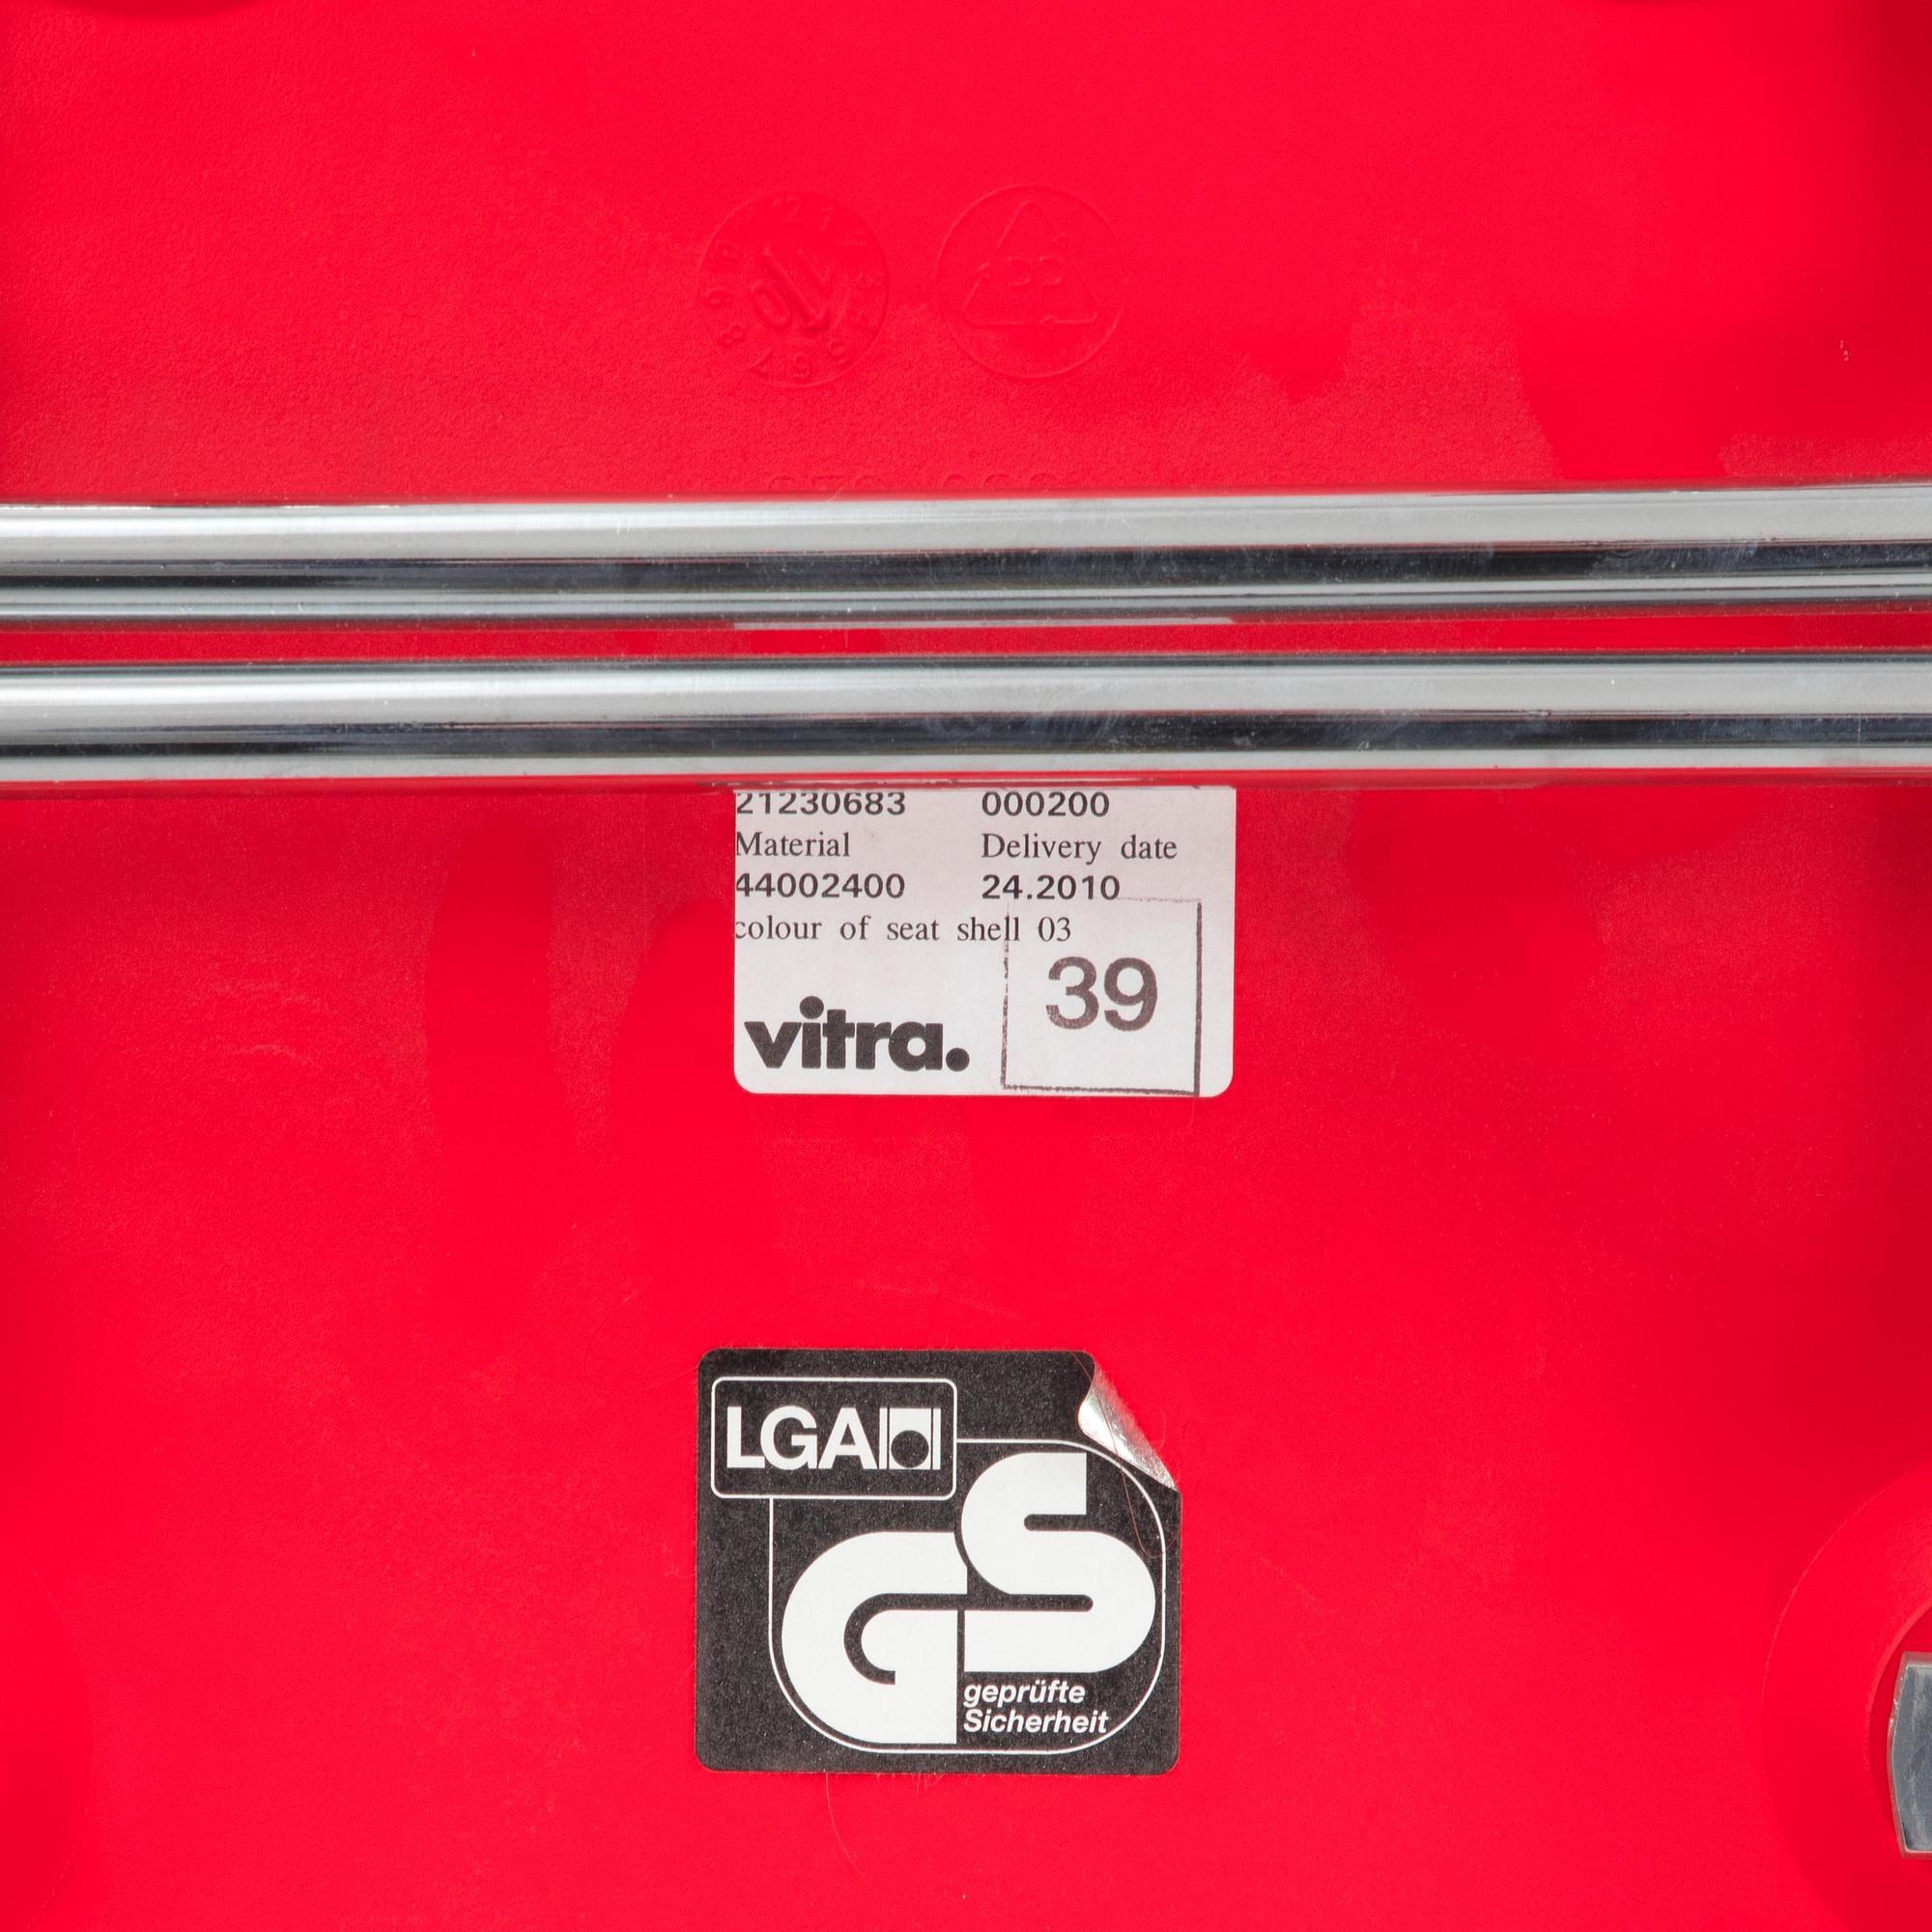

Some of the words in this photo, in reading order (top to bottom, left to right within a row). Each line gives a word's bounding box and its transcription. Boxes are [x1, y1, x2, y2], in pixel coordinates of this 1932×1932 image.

[771, 194, 804, 223] 12
[718, 321, 748, 349] 8
[736, 792, 906, 816] 21230683
[981, 792, 1110, 817] 000200
[736, 831, 850, 857] Material
[982, 833, 1102, 866] Delivery
[1121, 834, 1178, 860] date
[736, 872, 906, 898] 44002400
[981, 874, 1121, 900] 24.2010
[735, 915, 822, 940] colour
[839, 915, 872, 940] of
[887, 920, 940, 941] seat
[957, 915, 1020, 941] shell
[1037, 917, 1072, 942] 03
[1045, 956, 1158, 1032] 39
[744, 995, 970, 1072] vitra.
[781, 1451, 1157, 1746] GS
[962, 1679, 1087, 1705] geprüfte
[963, 1708, 1110, 1735] Sicherheit
